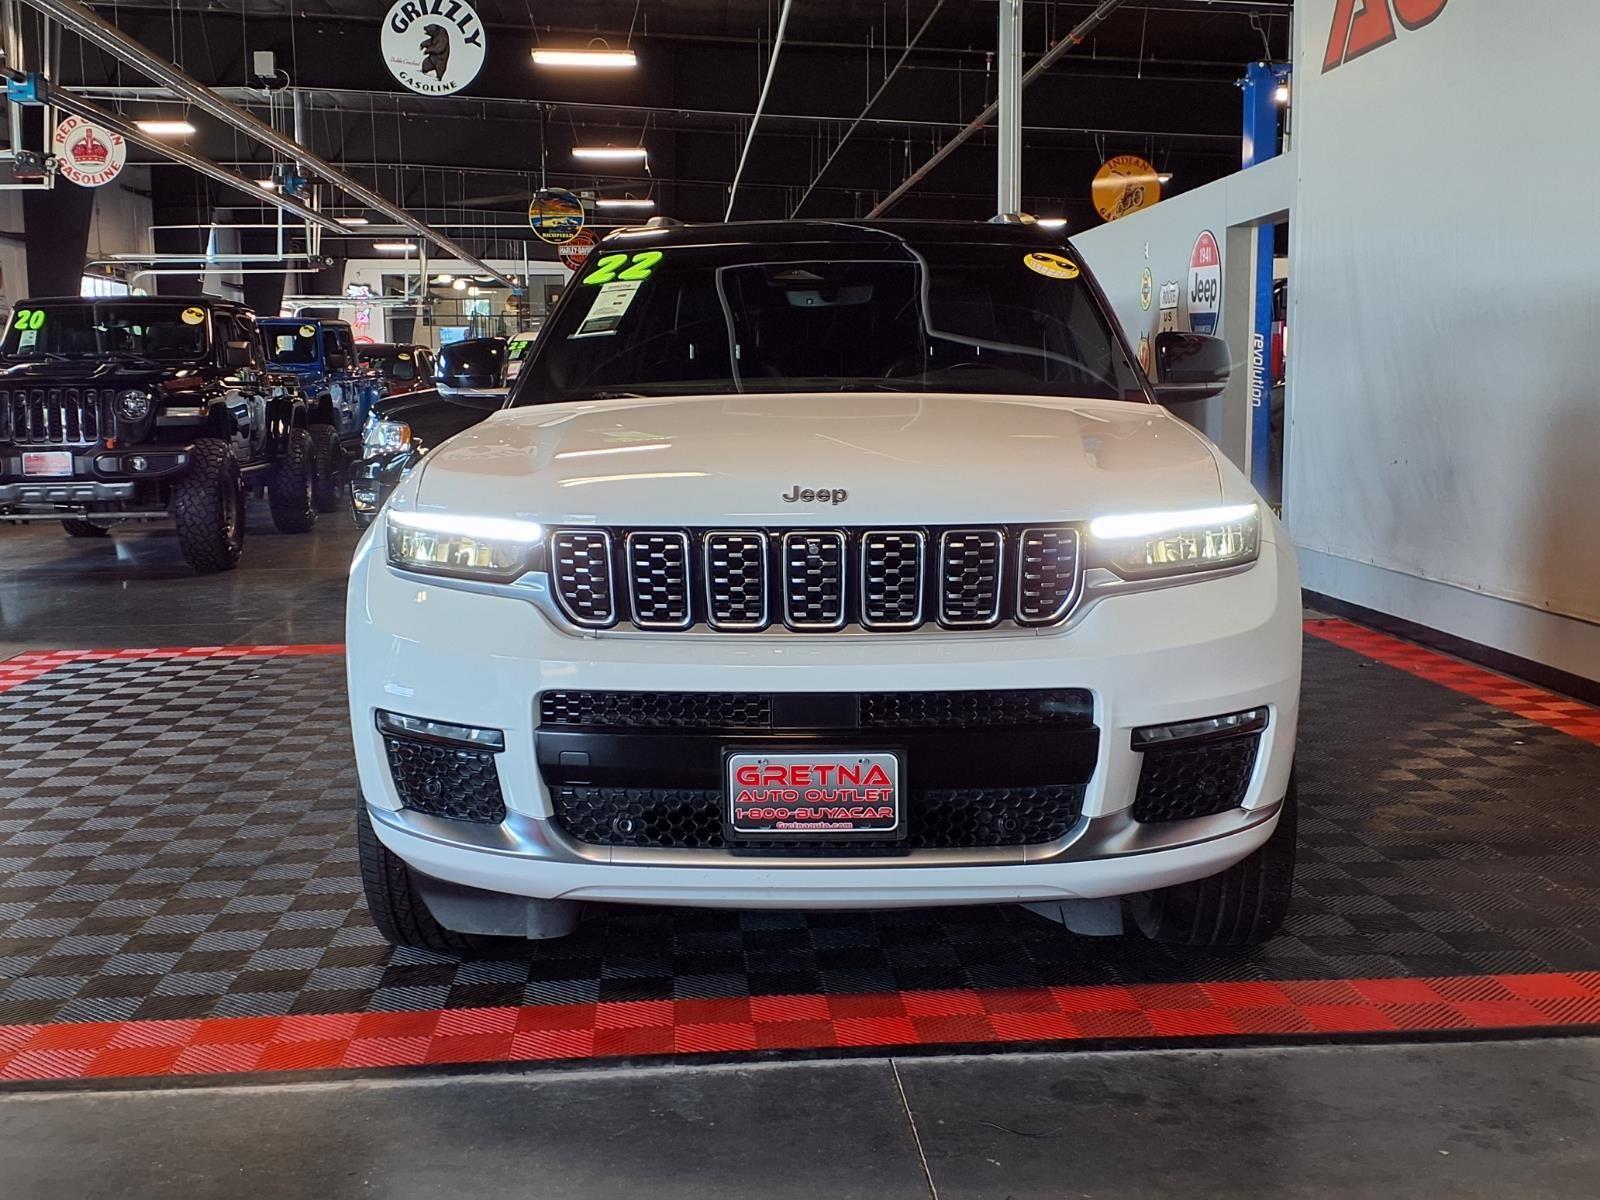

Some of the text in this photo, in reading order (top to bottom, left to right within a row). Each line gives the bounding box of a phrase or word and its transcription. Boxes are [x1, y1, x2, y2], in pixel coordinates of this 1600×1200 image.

[391, 0, 481, 48] GRIZZLY
[399, 71, 458, 92] GASOLINE
[56, 118, 77, 144] RED
[60, 157, 121, 184] GASOLINE
[1108, 157, 1148, 171] INDIAN
[582, 251, 663, 285] 22
[1191, 272, 1217, 309] Jeep
[14, 309, 46, 331] 20
[1163, 311, 1173, 323] US
[1252, 333, 1265, 408] revolution
[782, 485, 848, 506] Jeep
[735, 763, 893, 788] GRETNA
[735, 788, 894, 803] AUTO OUTLET
[735, 806, 894, 820] 1-800-BUYACAR
